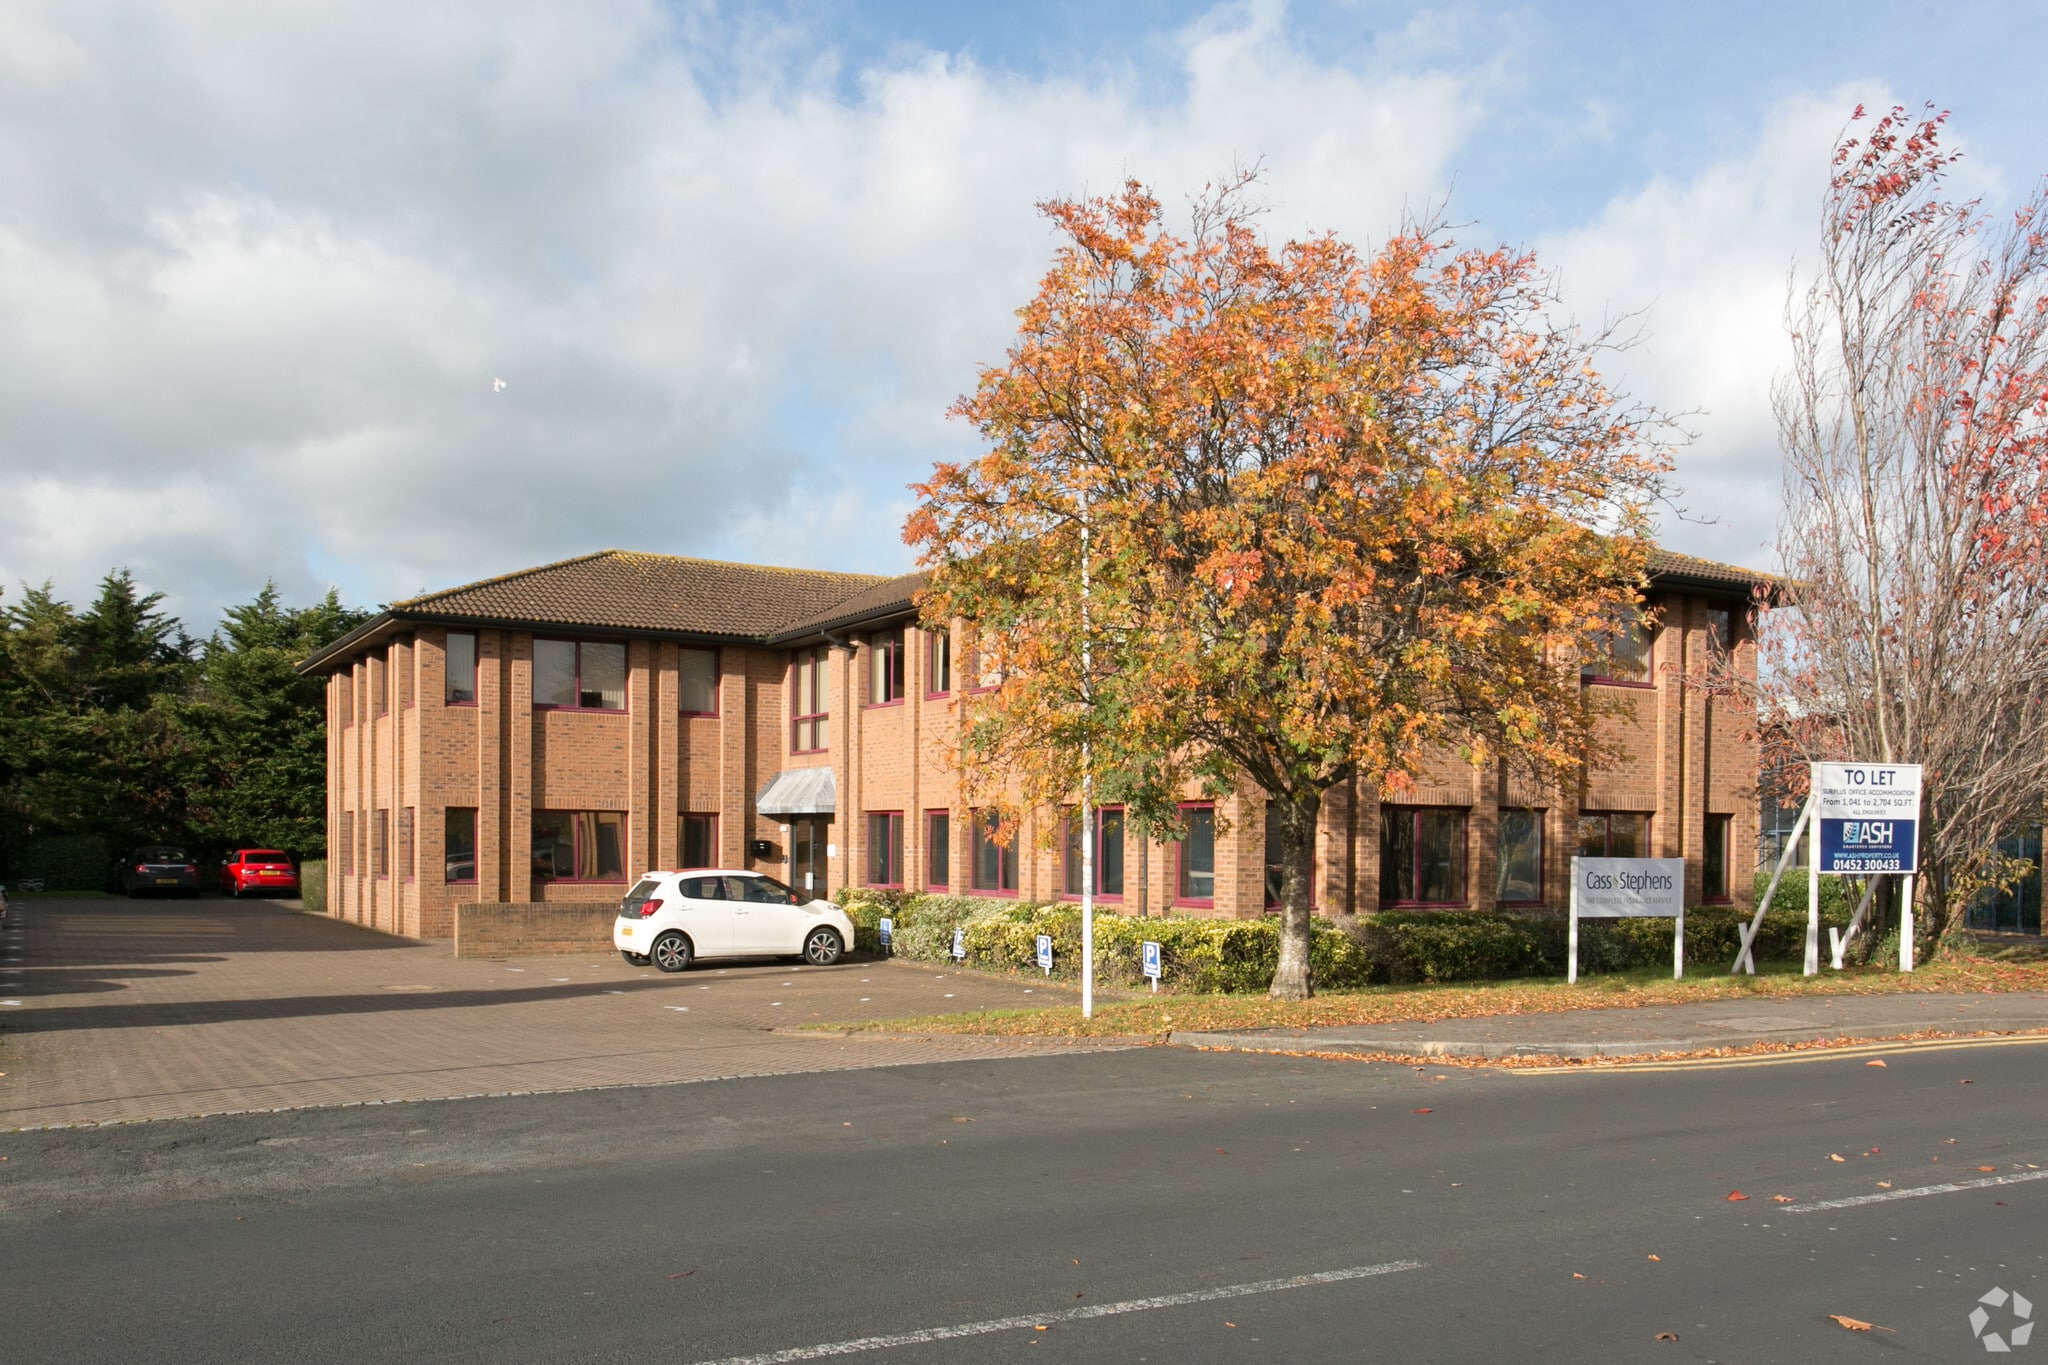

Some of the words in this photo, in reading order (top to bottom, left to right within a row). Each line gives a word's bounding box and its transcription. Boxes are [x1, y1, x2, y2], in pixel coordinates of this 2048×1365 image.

[1844, 769, 1865, 785] TO
[1871, 770, 1896, 786] LET
[1848, 788, 1867, 796] OFFICE
[1823, 797, 1841, 806] From
[1842, 798, 1861, 807] 1,041
[1863, 798, 1871, 806] to
[1872, 798, 1891, 808] 2,704
[1859, 821, 1894, 844] ASH
[1833, 859, 1862, 870] 01452
[1863, 859, 1900, 871] 300433
[1586, 871, 1612, 890] Cass
[1619, 869, 1673, 895] Stephens
[1146, 945, 1156, 963] P
